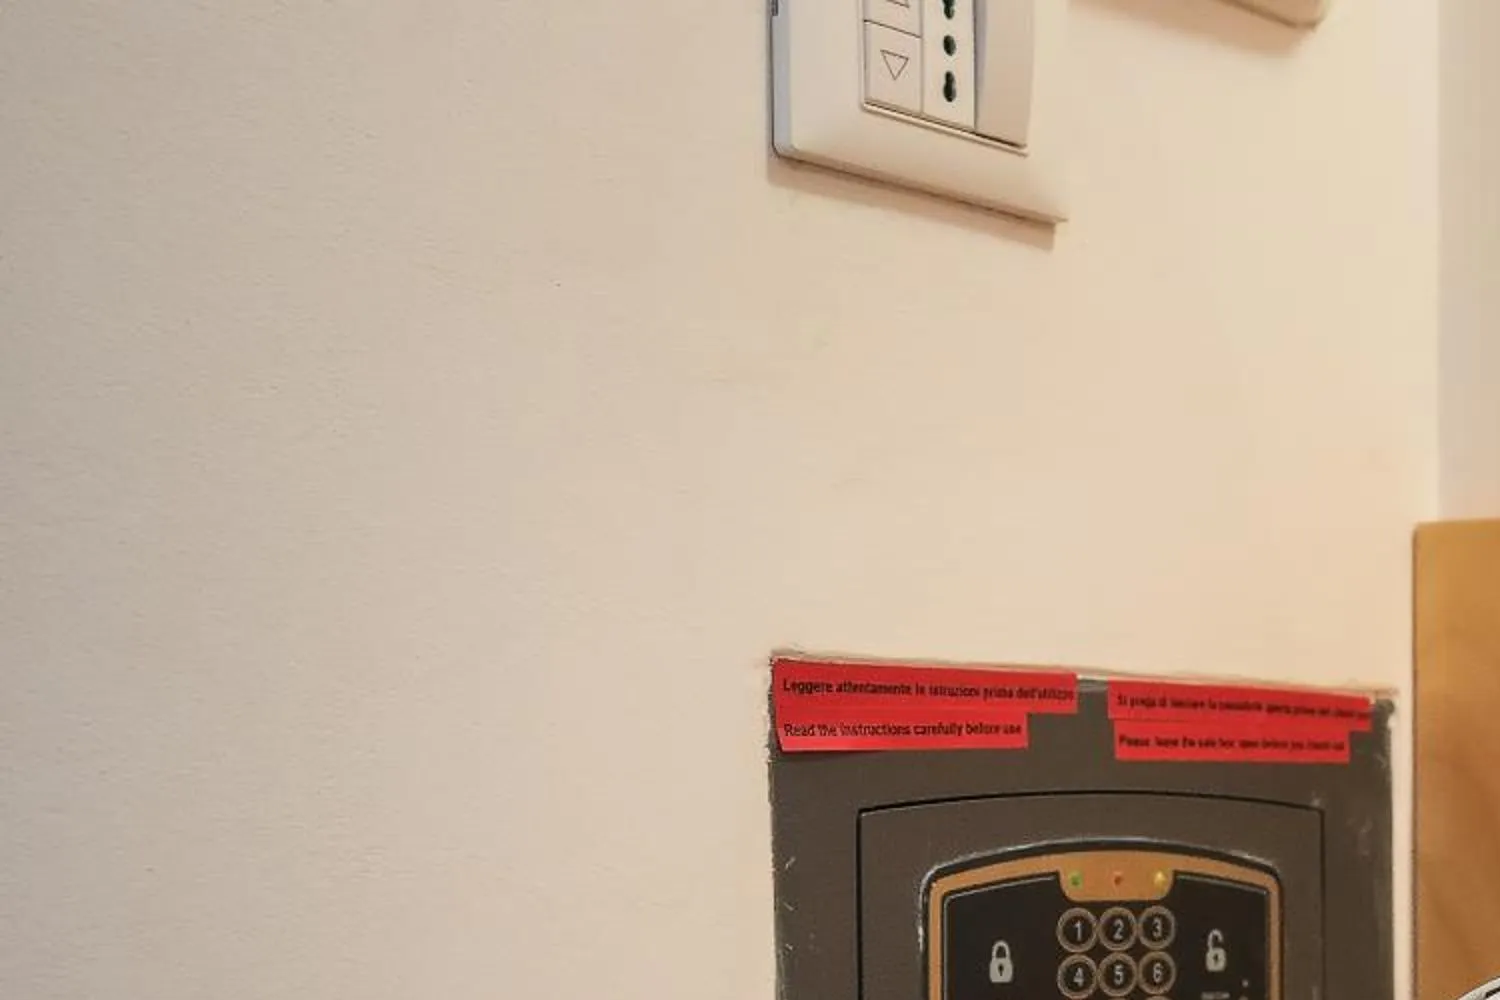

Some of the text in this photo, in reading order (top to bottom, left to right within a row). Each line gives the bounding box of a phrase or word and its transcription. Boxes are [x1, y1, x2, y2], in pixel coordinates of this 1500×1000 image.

[783, 679, 833, 695] Leggere
[835, 680, 912, 695] attentamente
[915, 682, 925, 695] le
[983, 686, 1014, 702] prima
[783, 721, 1022, 737] Read the instructions carefully before use
[1073, 917, 1162, 940] 1 2 3
[1072, 962, 1163, 987] 4 5 6
